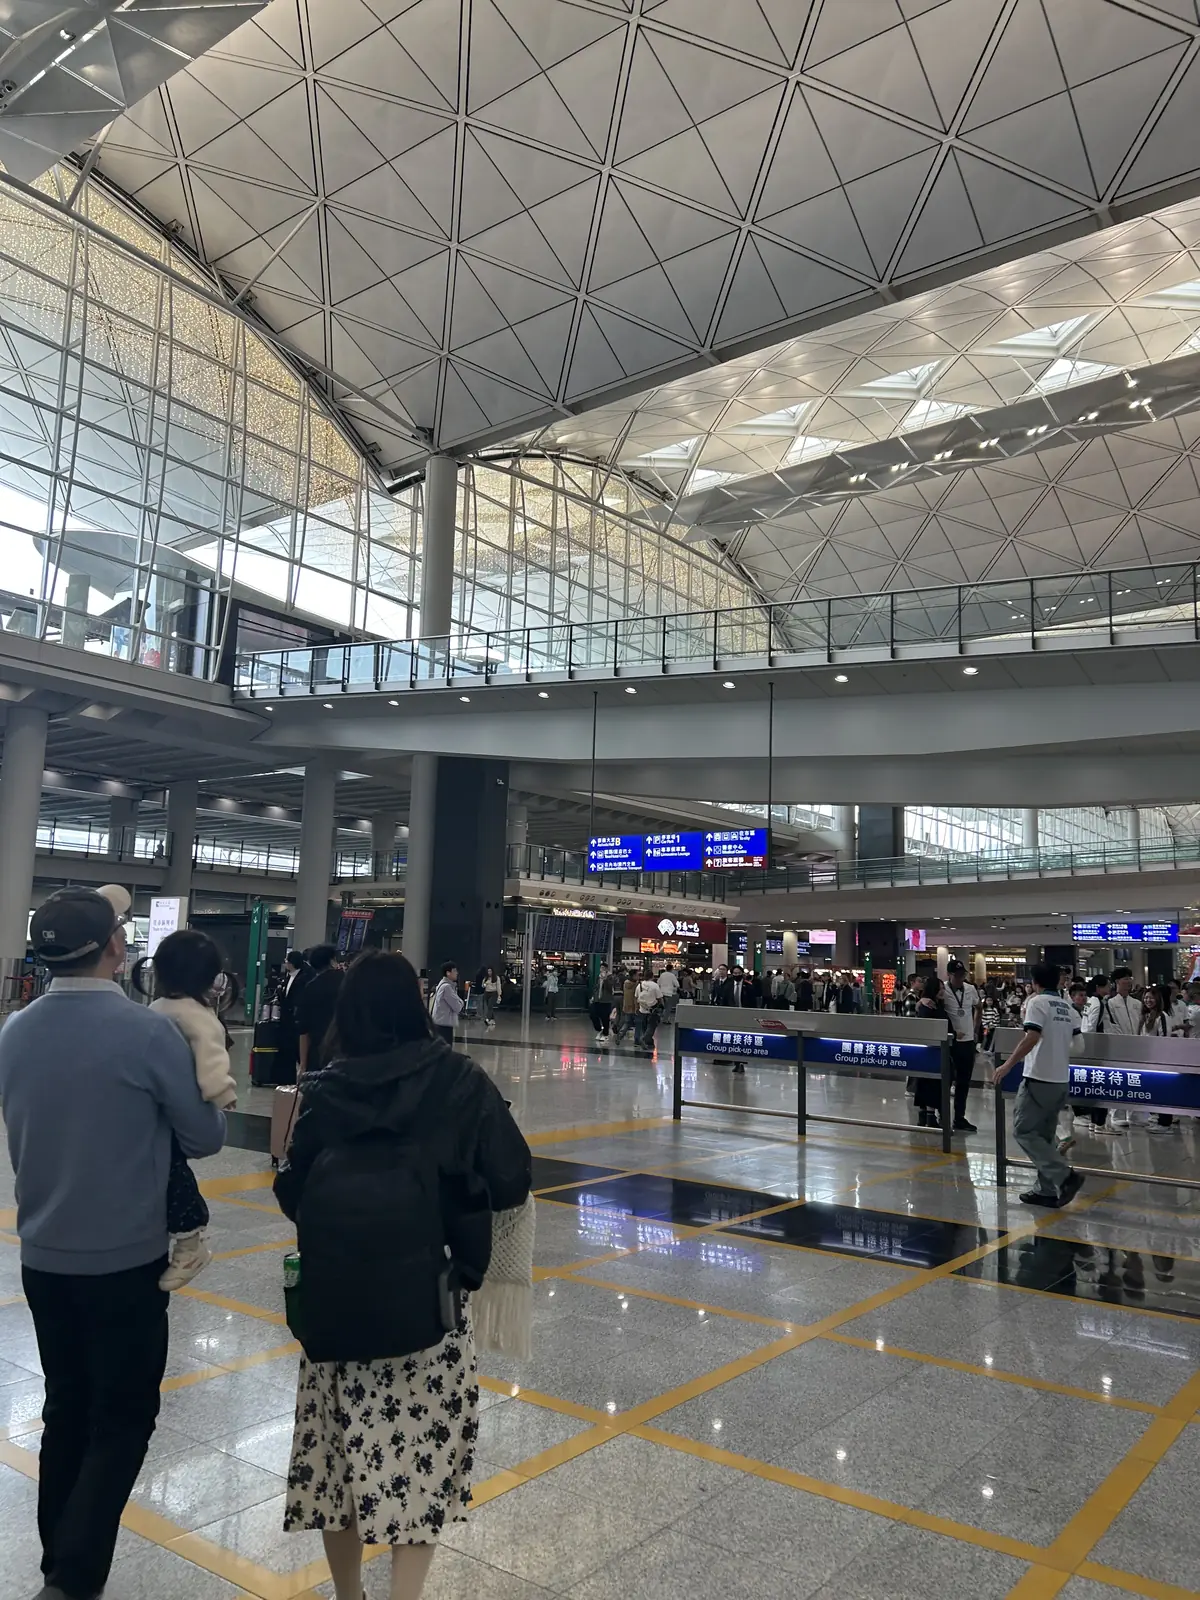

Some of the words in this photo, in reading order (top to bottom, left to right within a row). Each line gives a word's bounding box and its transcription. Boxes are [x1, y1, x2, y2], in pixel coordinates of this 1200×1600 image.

[615, 837, 621, 846] B
[676, 835, 680, 843] 1
[712, 1032, 764, 1047] 團體接待區
[706, 1043, 727, 1053] Group
[728, 1045, 752, 1055] pick-up
[753, 1048, 769, 1056] area
[841, 1042, 901, 1057] 團體接待區
[835, 1053, 859, 1064] Group
[860, 1056, 888, 1066] pick-up
[889, 1059, 907, 1067] area
[1069, 1068, 1142, 1087] 體接待區
[1084, 1085, 1124, 1099] pick-up
[1126, 1090, 1152, 1100] area
